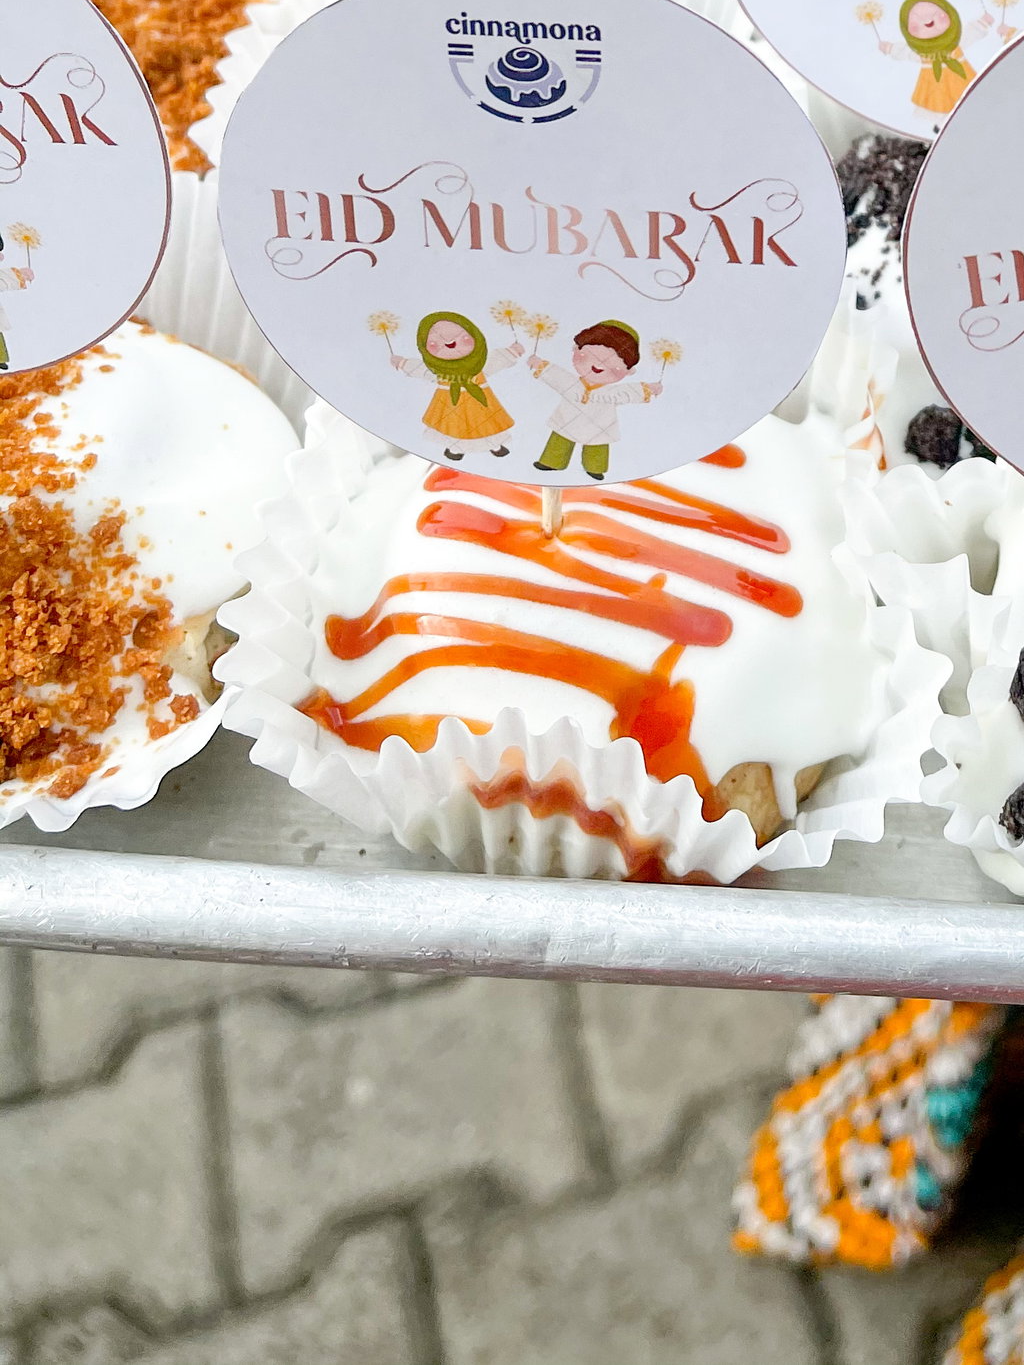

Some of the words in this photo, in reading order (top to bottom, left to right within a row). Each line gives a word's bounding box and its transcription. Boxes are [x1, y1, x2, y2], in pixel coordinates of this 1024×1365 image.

[444, 11, 603, 45] cinnamona
[264, 187, 397, 281] EID
[422, 160, 804, 302] MUBARAK
